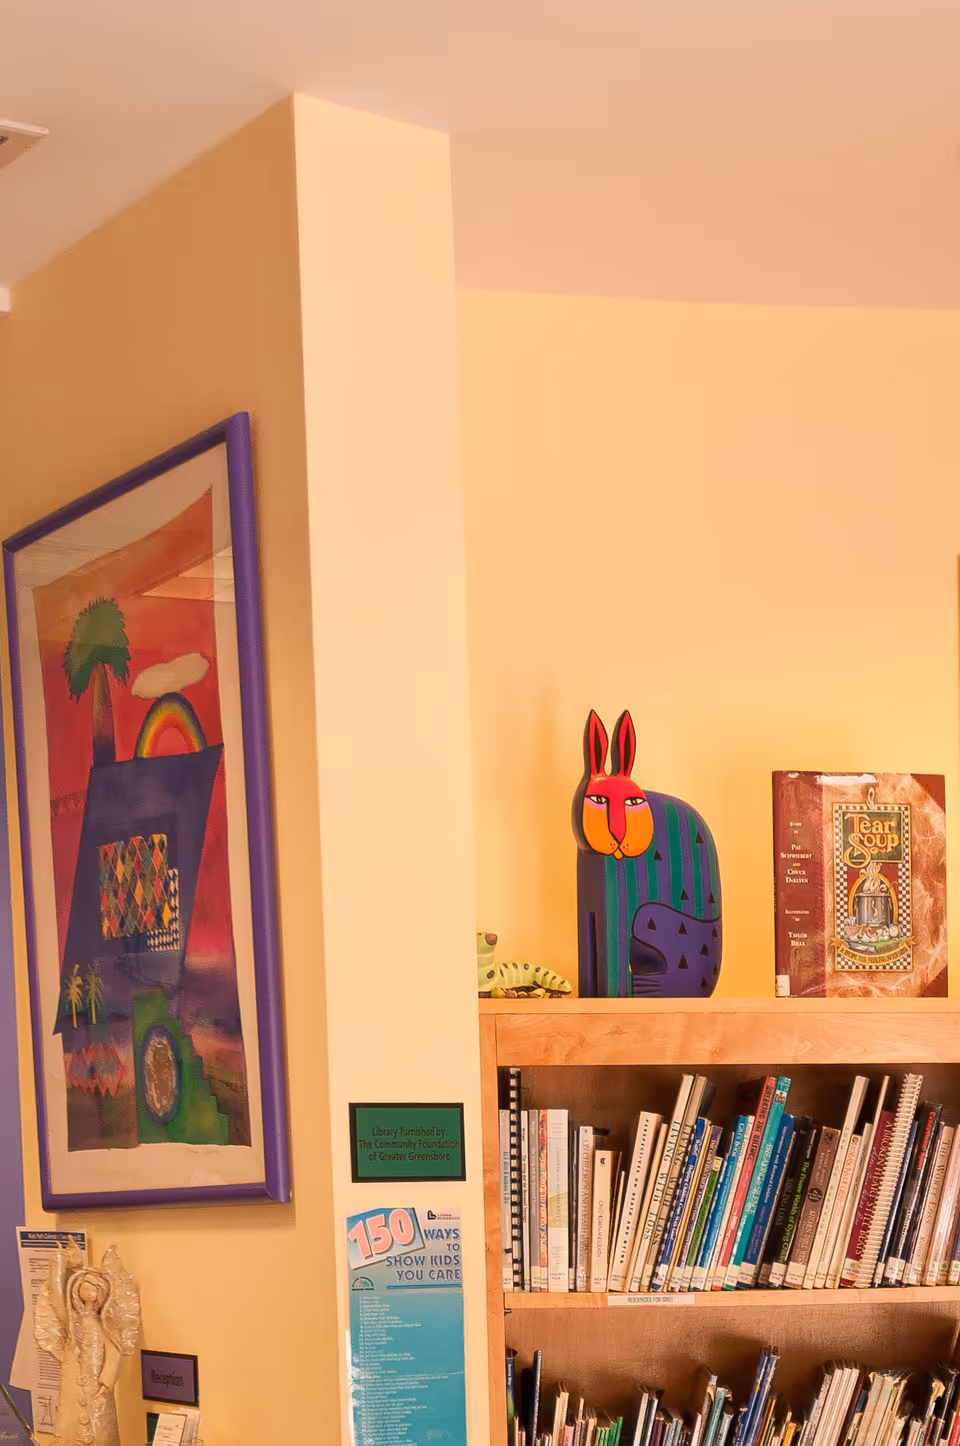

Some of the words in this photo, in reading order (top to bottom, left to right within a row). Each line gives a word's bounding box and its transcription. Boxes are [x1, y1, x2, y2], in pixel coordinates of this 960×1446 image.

[844, 813, 896, 834] Tear
[846, 833, 898, 868] Soup
[372, 1126, 398, 1137] Library
[400, 1127, 434, 1136] furnished
[436, 1127, 445, 1138] by
[664, 1120, 681, 1162] LIVING
[359, 1139, 373, 1148] The
[374, 1139, 417, 1150] Community
[419, 1139, 460, 1149] Foundation
[368, 1152, 378, 1161] of
[379, 1152, 406, 1161] Greater
[408, 1151, 450, 1161] Greensboro
[636, 1119, 649, 1173] PERSPECTIVES
[938, 1140, 950, 1159] THE
[633, 1178, 638, 1188] ON
[653, 1172, 668, 1202] WITH
[931, 1164, 945, 1199] WORST
[628, 1192, 636, 1216] DEATH
[925, 1202, 937, 1225] LOSS
[348, 1208, 415, 1258] 150
[423, 1228, 459, 1239] WAYS
[644, 1212, 657, 1241] LOSS
[386, 1255, 426, 1267] SHOW
[431, 1255, 460, 1266] KIDS
[620, 1240, 628, 1264] DYING
[396, 1270, 423, 1281] YOU
[429, 1269, 460, 1280] CARE
